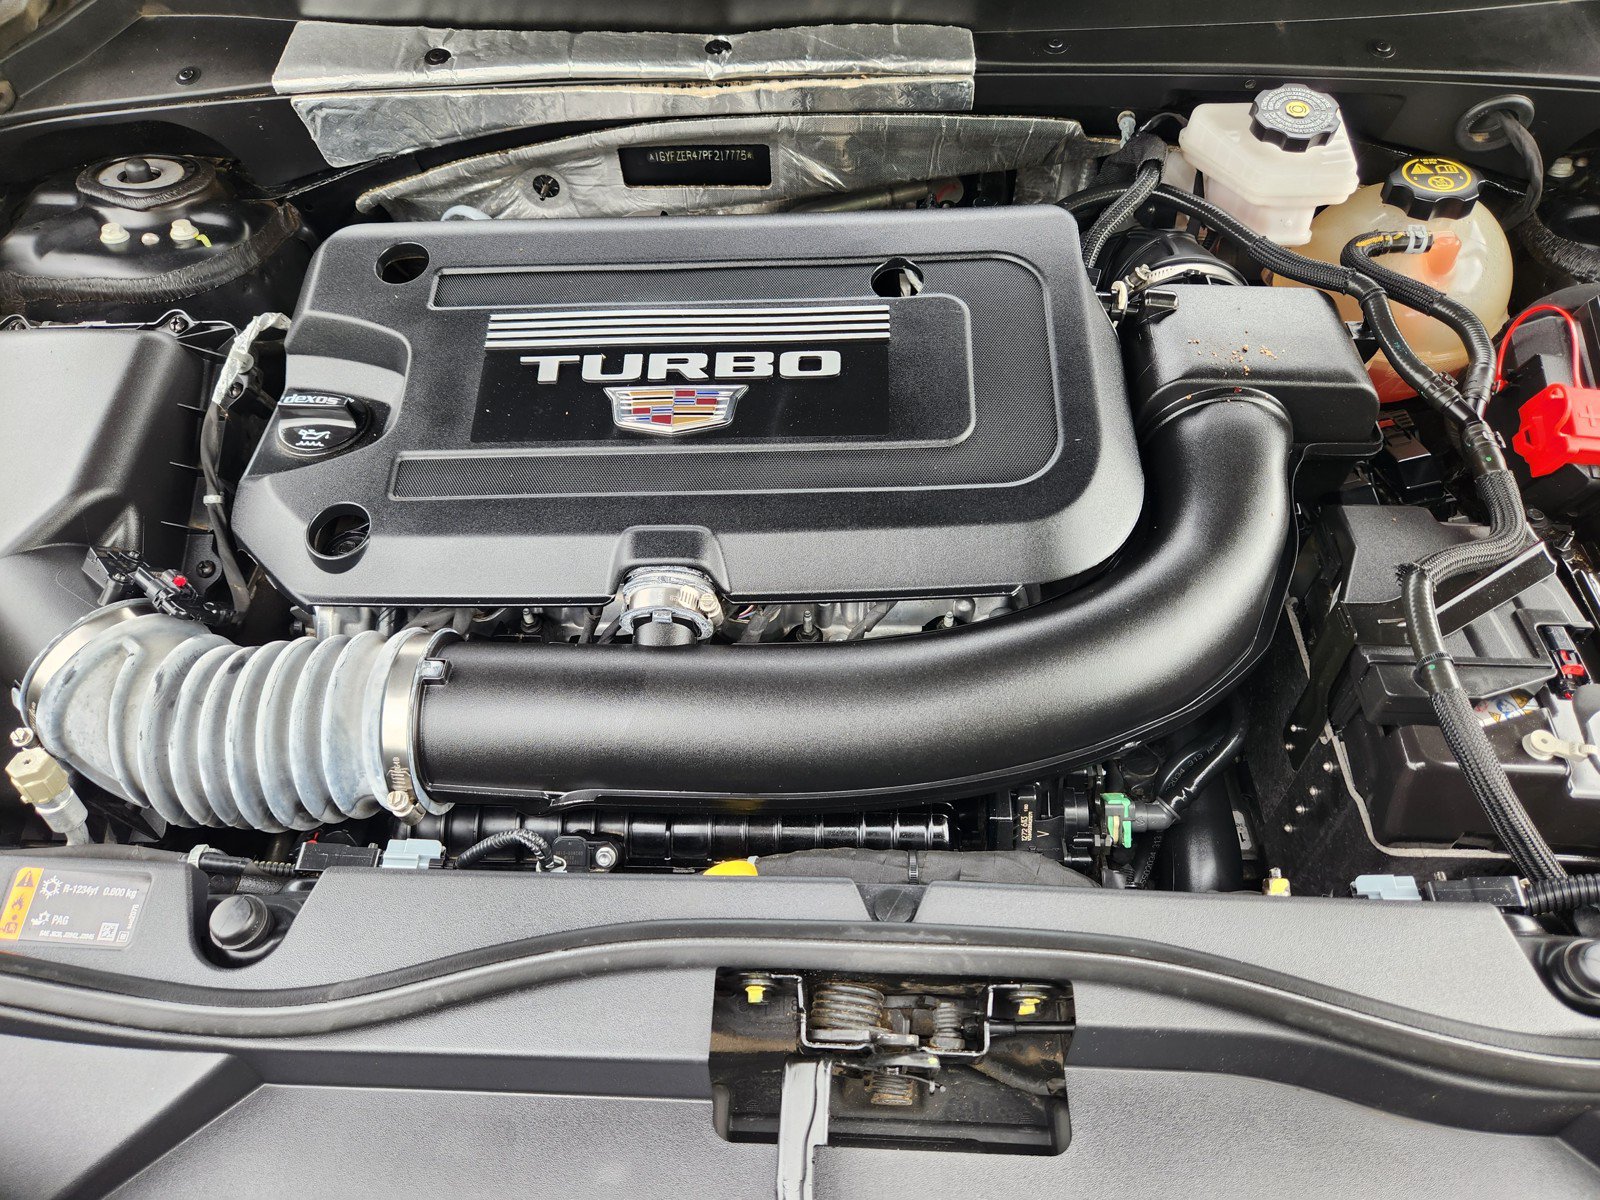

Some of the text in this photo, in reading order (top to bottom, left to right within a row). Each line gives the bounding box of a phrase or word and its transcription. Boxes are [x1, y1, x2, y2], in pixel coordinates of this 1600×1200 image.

[520, 350, 842, 385] TURBO
[283, 394, 342, 405] dexos
[125, 888, 137, 899] kg
[51, 915, 70, 926] PAG
